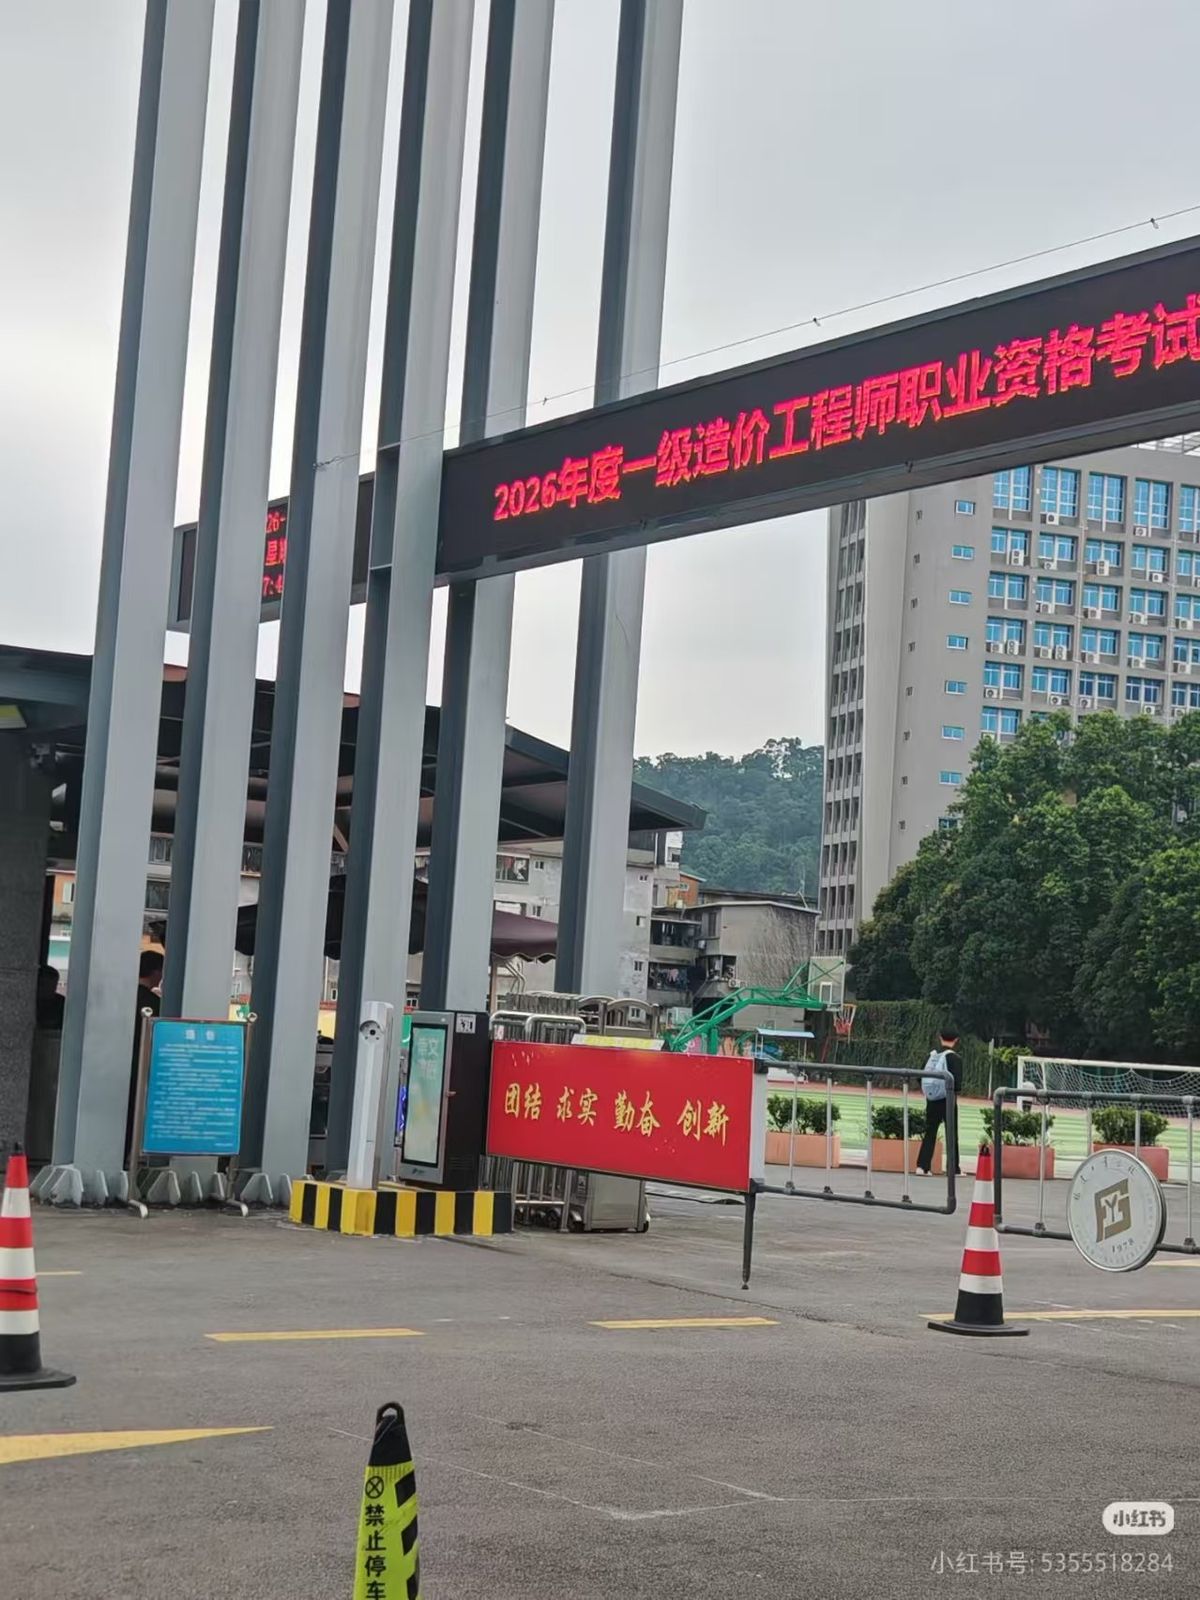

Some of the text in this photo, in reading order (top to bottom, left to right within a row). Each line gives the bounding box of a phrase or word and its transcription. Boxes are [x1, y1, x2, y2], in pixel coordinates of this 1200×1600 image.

[494, 293, 1200, 520] 2026年度一级造价工程师职业资格考试
[505, 1083, 729, 1146] 团结 求实 勤奋 创新
[364, 1504, 387, 1600] 禁止停车
